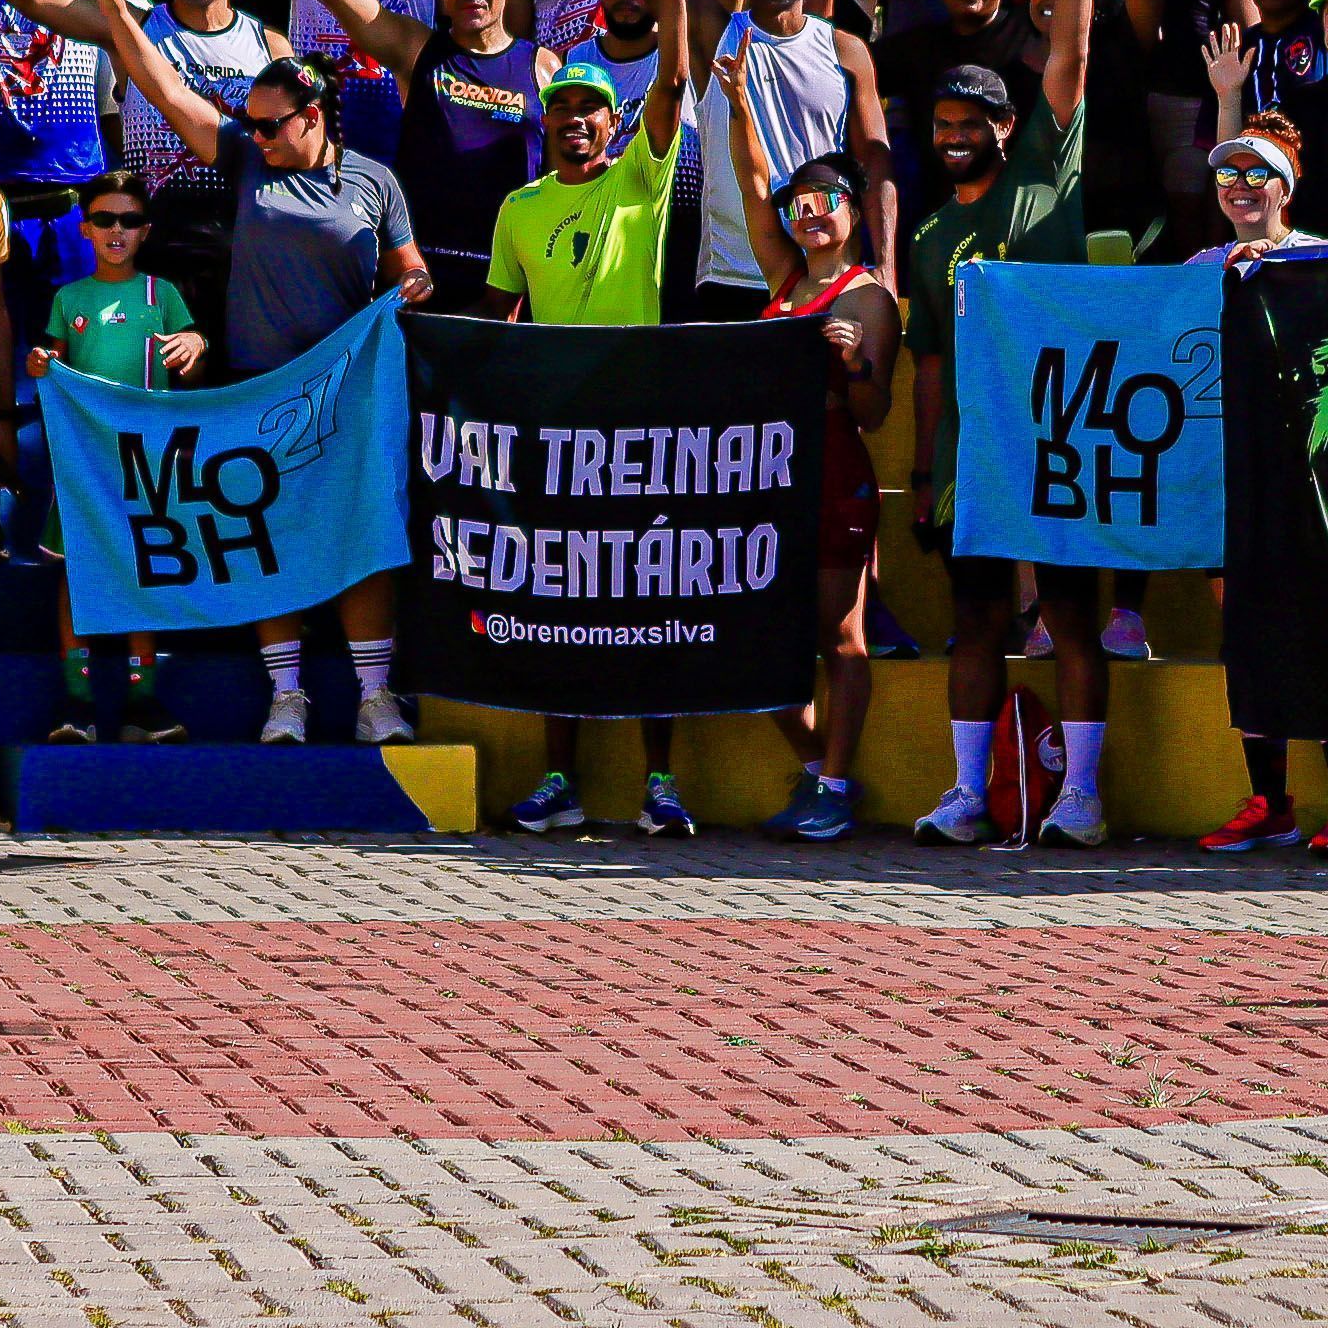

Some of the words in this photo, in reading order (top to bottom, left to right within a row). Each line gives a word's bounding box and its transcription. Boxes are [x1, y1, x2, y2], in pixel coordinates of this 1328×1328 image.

[185, 63, 246, 80] CORRIDA
[450, 95, 498, 112] MOVIMENTA
[499, 103, 524, 116] LUZIA
[491, 111, 523, 123] 2026
[1030, 340, 1185, 456] MO
[1172, 327, 1223, 420] 2
[118, 426, 280, 517] MO
[258, 351, 350, 475] 27
[420, 412, 519, 493] VAI
[539, 420, 794, 496] TREINAR
[1030, 439, 1159, 527] BH
[127, 512, 280, 588] BH
[432, 514, 778, 598] SEDENTÁRIO
[486, 613, 716, 646] @brenomaxsilva
